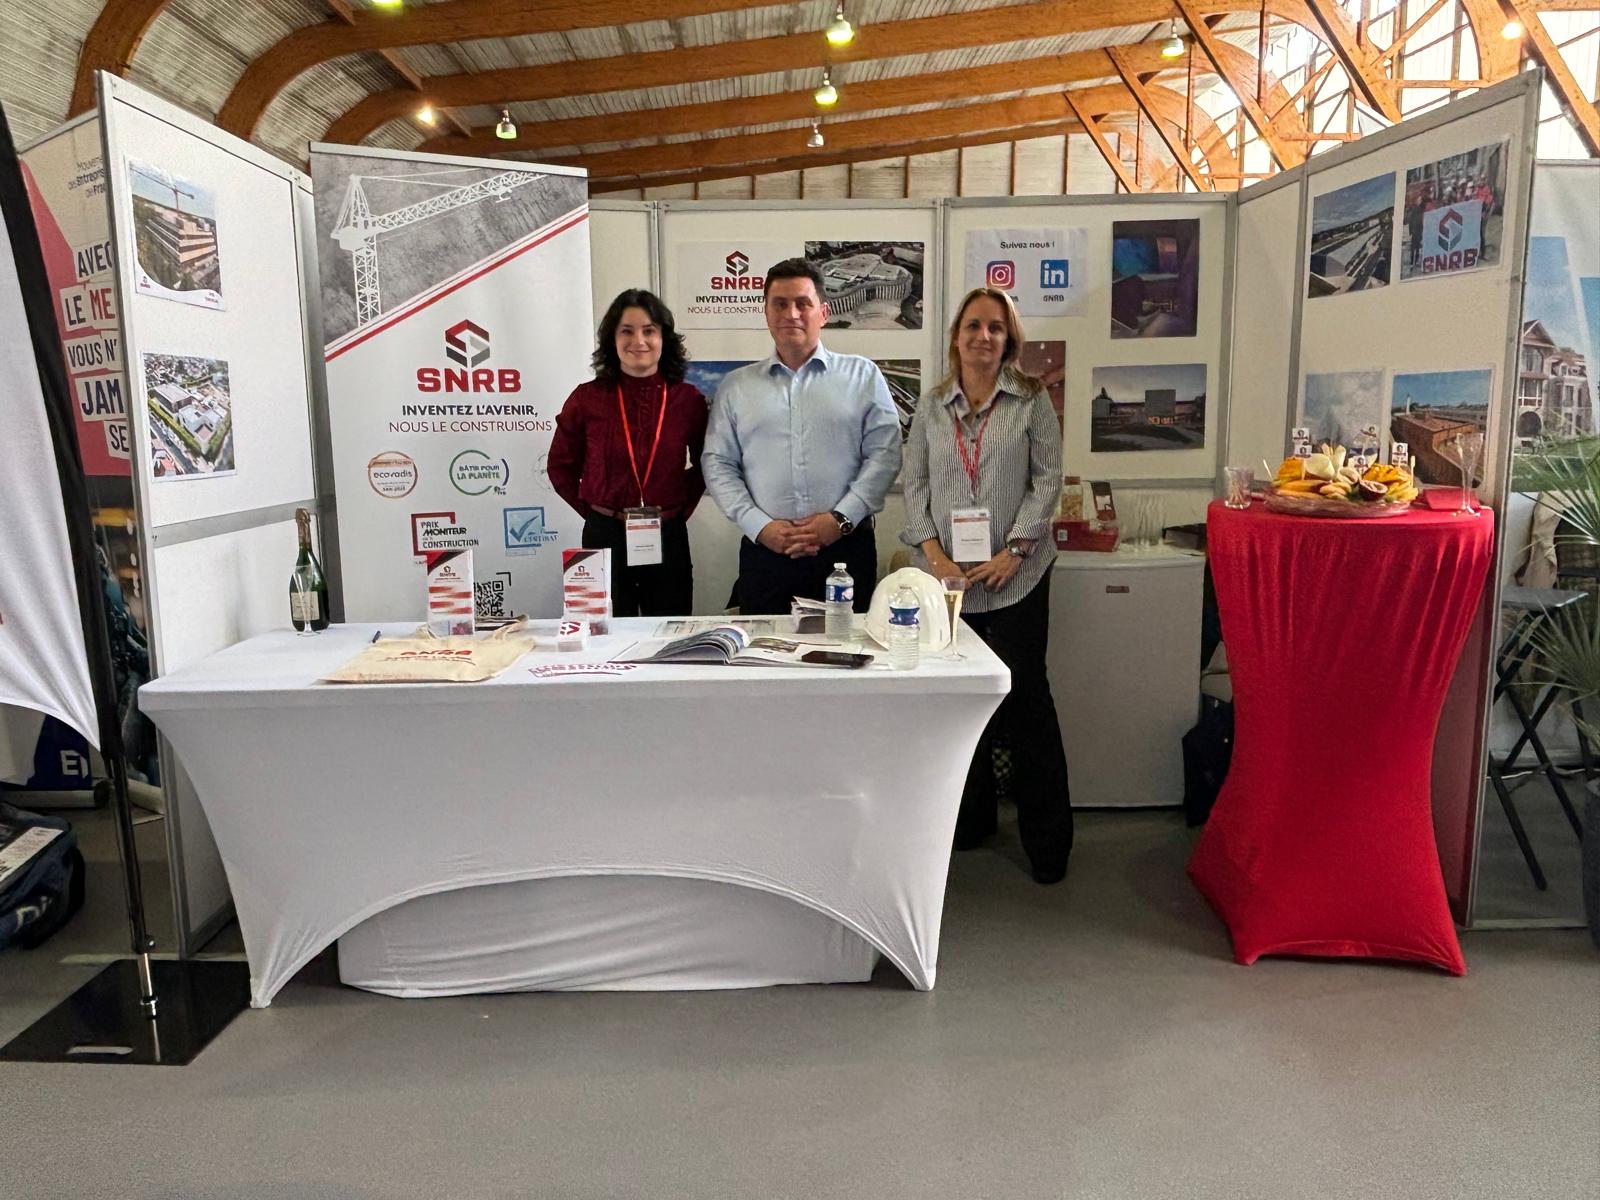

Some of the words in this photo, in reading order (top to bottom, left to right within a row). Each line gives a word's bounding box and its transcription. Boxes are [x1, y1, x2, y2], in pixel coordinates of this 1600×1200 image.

[1000, 241, 1028, 249] Suivez
[1029, 241, 1050, 249] nous
[1423, 248, 1479, 273] SNRB
[710, 276, 764, 290] SNRB
[65, 295, 86, 326] LE
[688, 306, 711, 314] NOUS
[67, 342, 102, 368] VOUS
[416, 367, 522, 393] SNRB
[81, 379, 125, 415] JAM
[402, 404, 473, 416] INVENTEZ
[477, 404, 538, 418] L'AVENIR,
[389, 421, 428, 433] NOUS
[432, 421, 447, 432] LE
[450, 420, 552, 432] CONSTRUISONS
[421, 521, 439, 529] PRIX
[422, 527, 467, 537] MONITEUR
[422, 539, 479, 549] CONSTRUCTION
